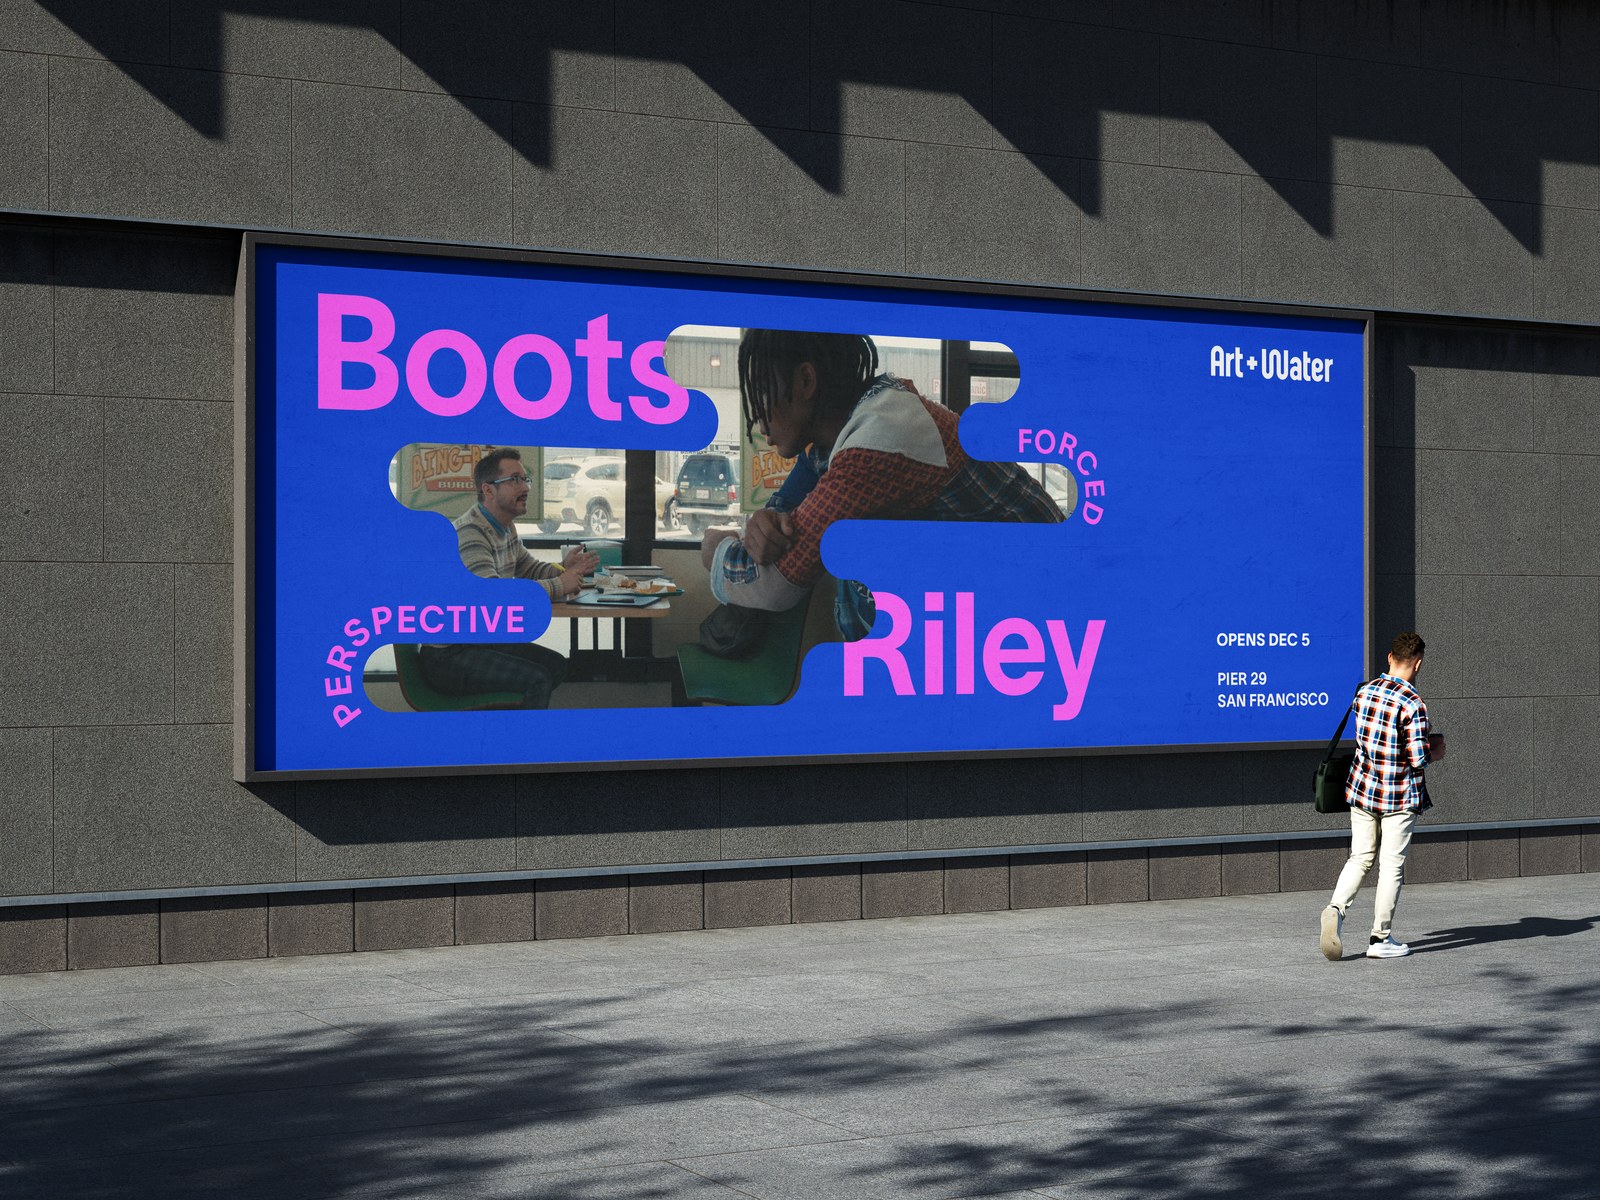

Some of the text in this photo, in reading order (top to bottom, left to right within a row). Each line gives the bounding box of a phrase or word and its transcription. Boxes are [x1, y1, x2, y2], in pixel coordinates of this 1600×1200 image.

[318, 293, 690, 425] Boots
[438, 481, 475, 489] BURG
[1018, 428, 1106, 525] FORCED
[324, 604, 525, 729] PERSPECTIVE
[843, 591, 1107, 721] Riley
[1216, 632, 1311, 647] OPENS DEC 5
[1217, 671, 1267, 686] PIER 29
[1217, 691, 1329, 708] SAN FRANCISCO
